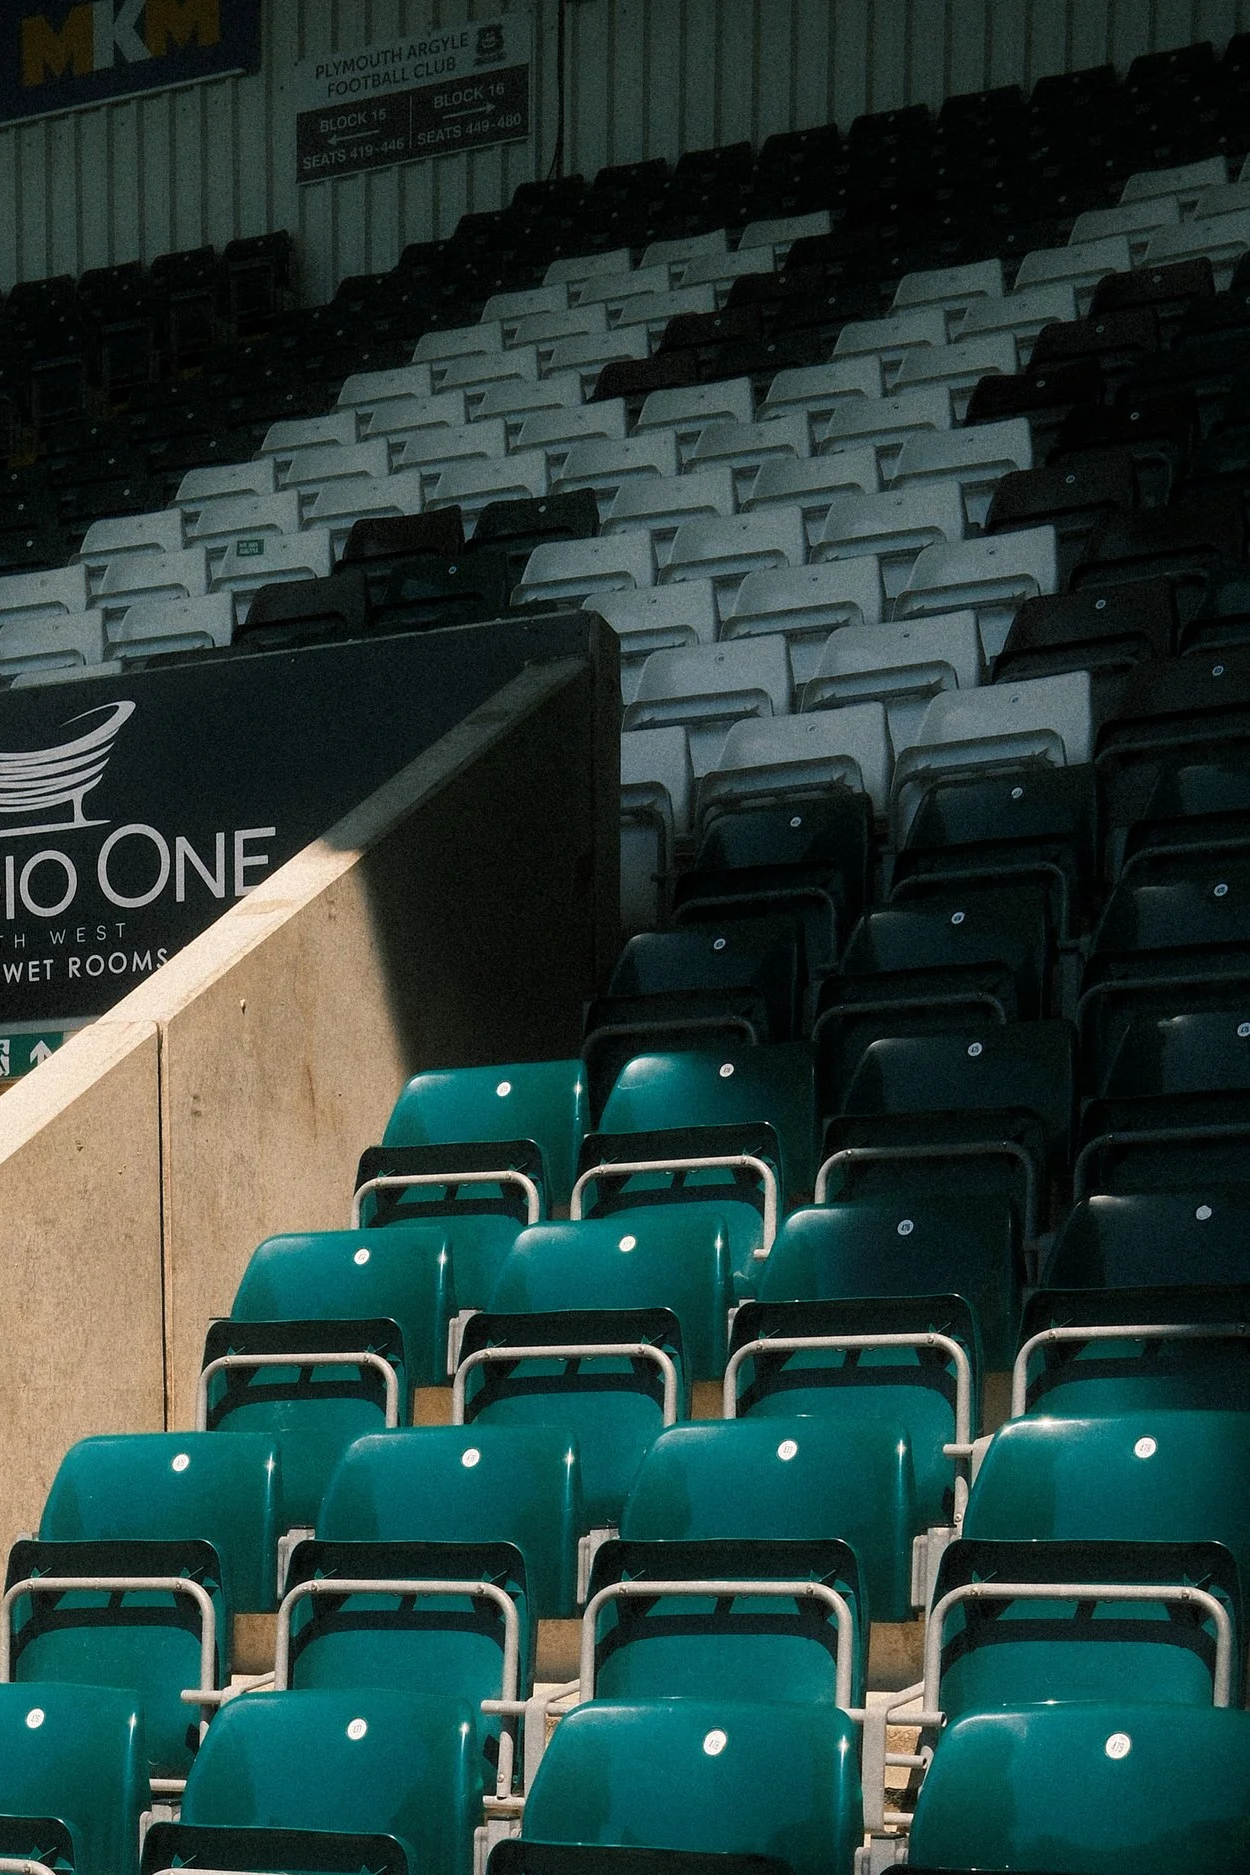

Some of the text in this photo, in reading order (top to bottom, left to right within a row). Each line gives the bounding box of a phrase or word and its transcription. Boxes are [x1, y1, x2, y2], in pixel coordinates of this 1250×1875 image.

[20, 0, 221, 86] MKM
[315, 46, 403, 80] PLYMOUTH
[407, 32, 469, 59] ARGYLE
[327, 69, 408, 98] FOOTBALL
[413, 56, 457, 78] CLUB
[433, 82, 505, 109] BLOCK 16
[319, 113, 367, 133] BLOCK
[417, 127, 461, 146] SEATS
[302, 151, 346, 170] SEATS
[97, 823, 276, 909] ONE
[50, 923, 127, 946] WEST
[68, 947, 168, 979] ROOMS
